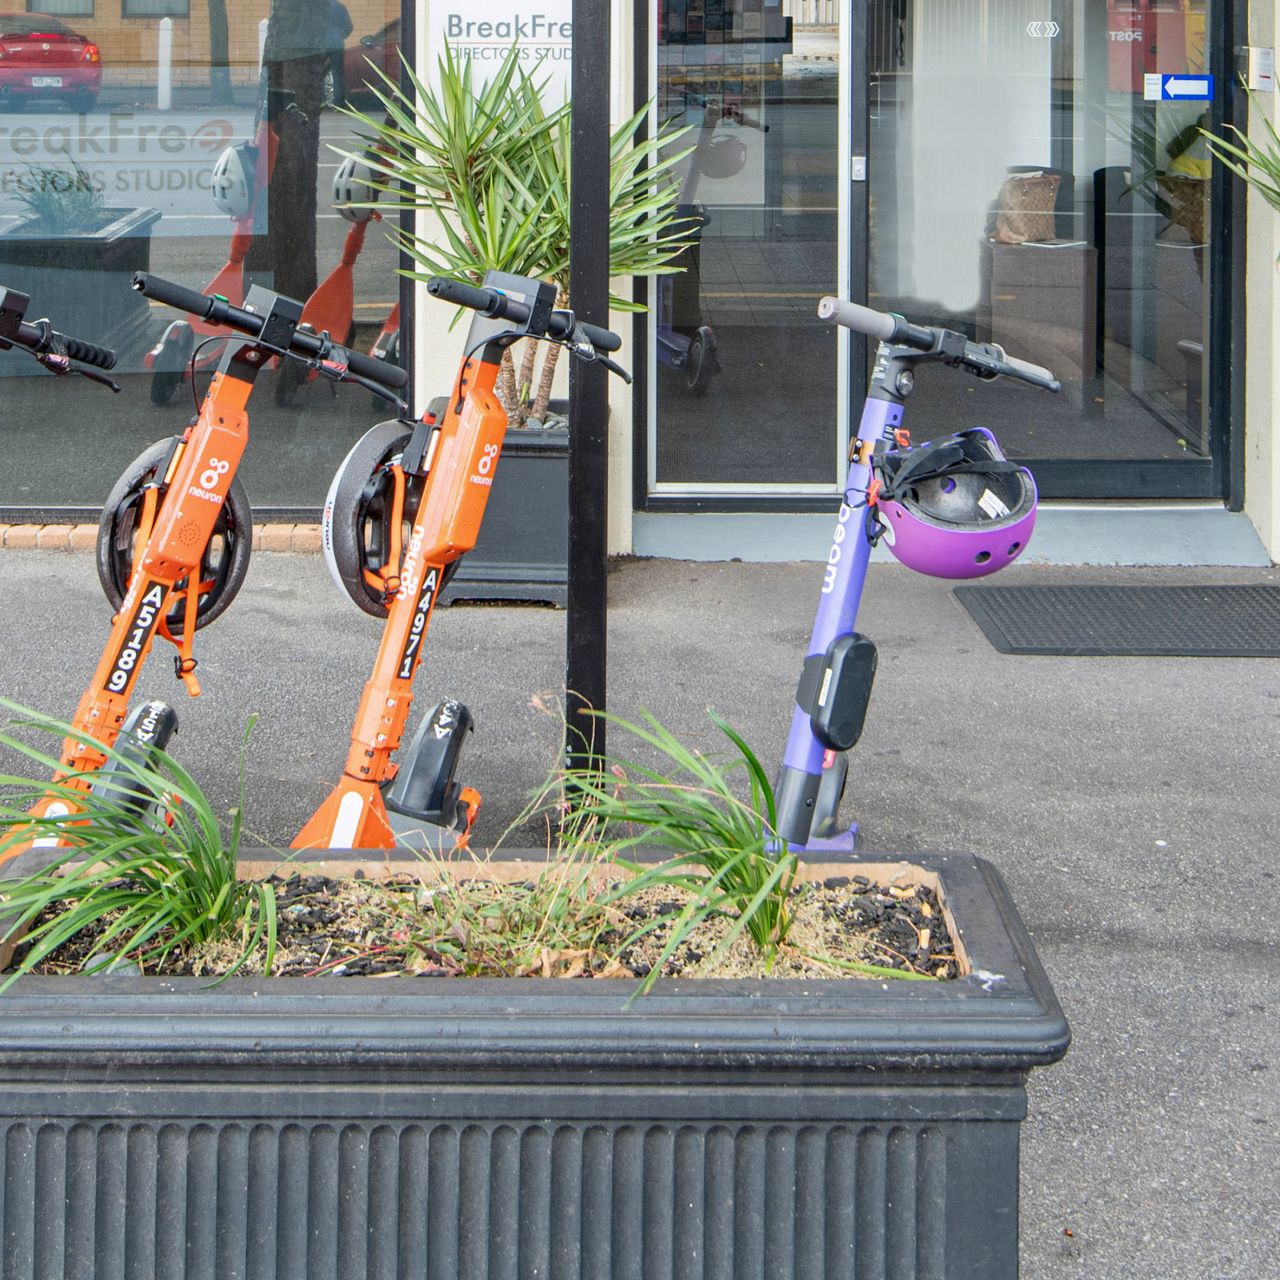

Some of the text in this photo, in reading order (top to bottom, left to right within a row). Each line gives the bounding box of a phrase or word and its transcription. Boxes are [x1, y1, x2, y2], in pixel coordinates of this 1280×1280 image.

[447, 13, 573, 39] BreakFre
[188, 486, 223, 504] neuron
[396, 524, 426, 601] neuron
[822, 503, 853, 595] beam
[108, 584, 163, 693] A5189
[399, 570, 437, 679] A4971
